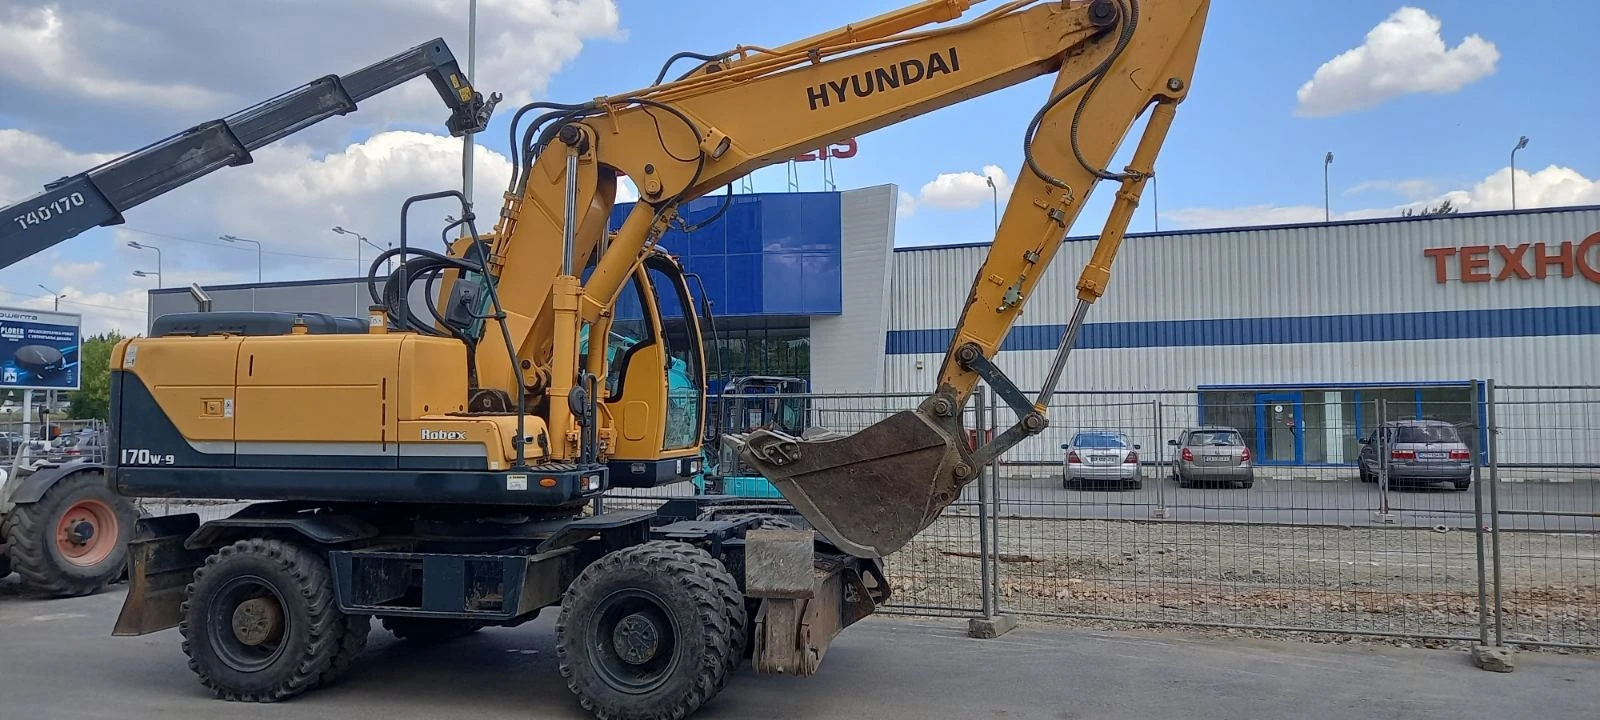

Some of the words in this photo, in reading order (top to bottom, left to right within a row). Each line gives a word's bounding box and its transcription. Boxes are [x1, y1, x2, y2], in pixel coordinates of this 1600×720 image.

[806, 47, 960, 110] HYUNDAI
[14, 191, 85, 230] T40170
[420, 428, 467, 440] Robex
